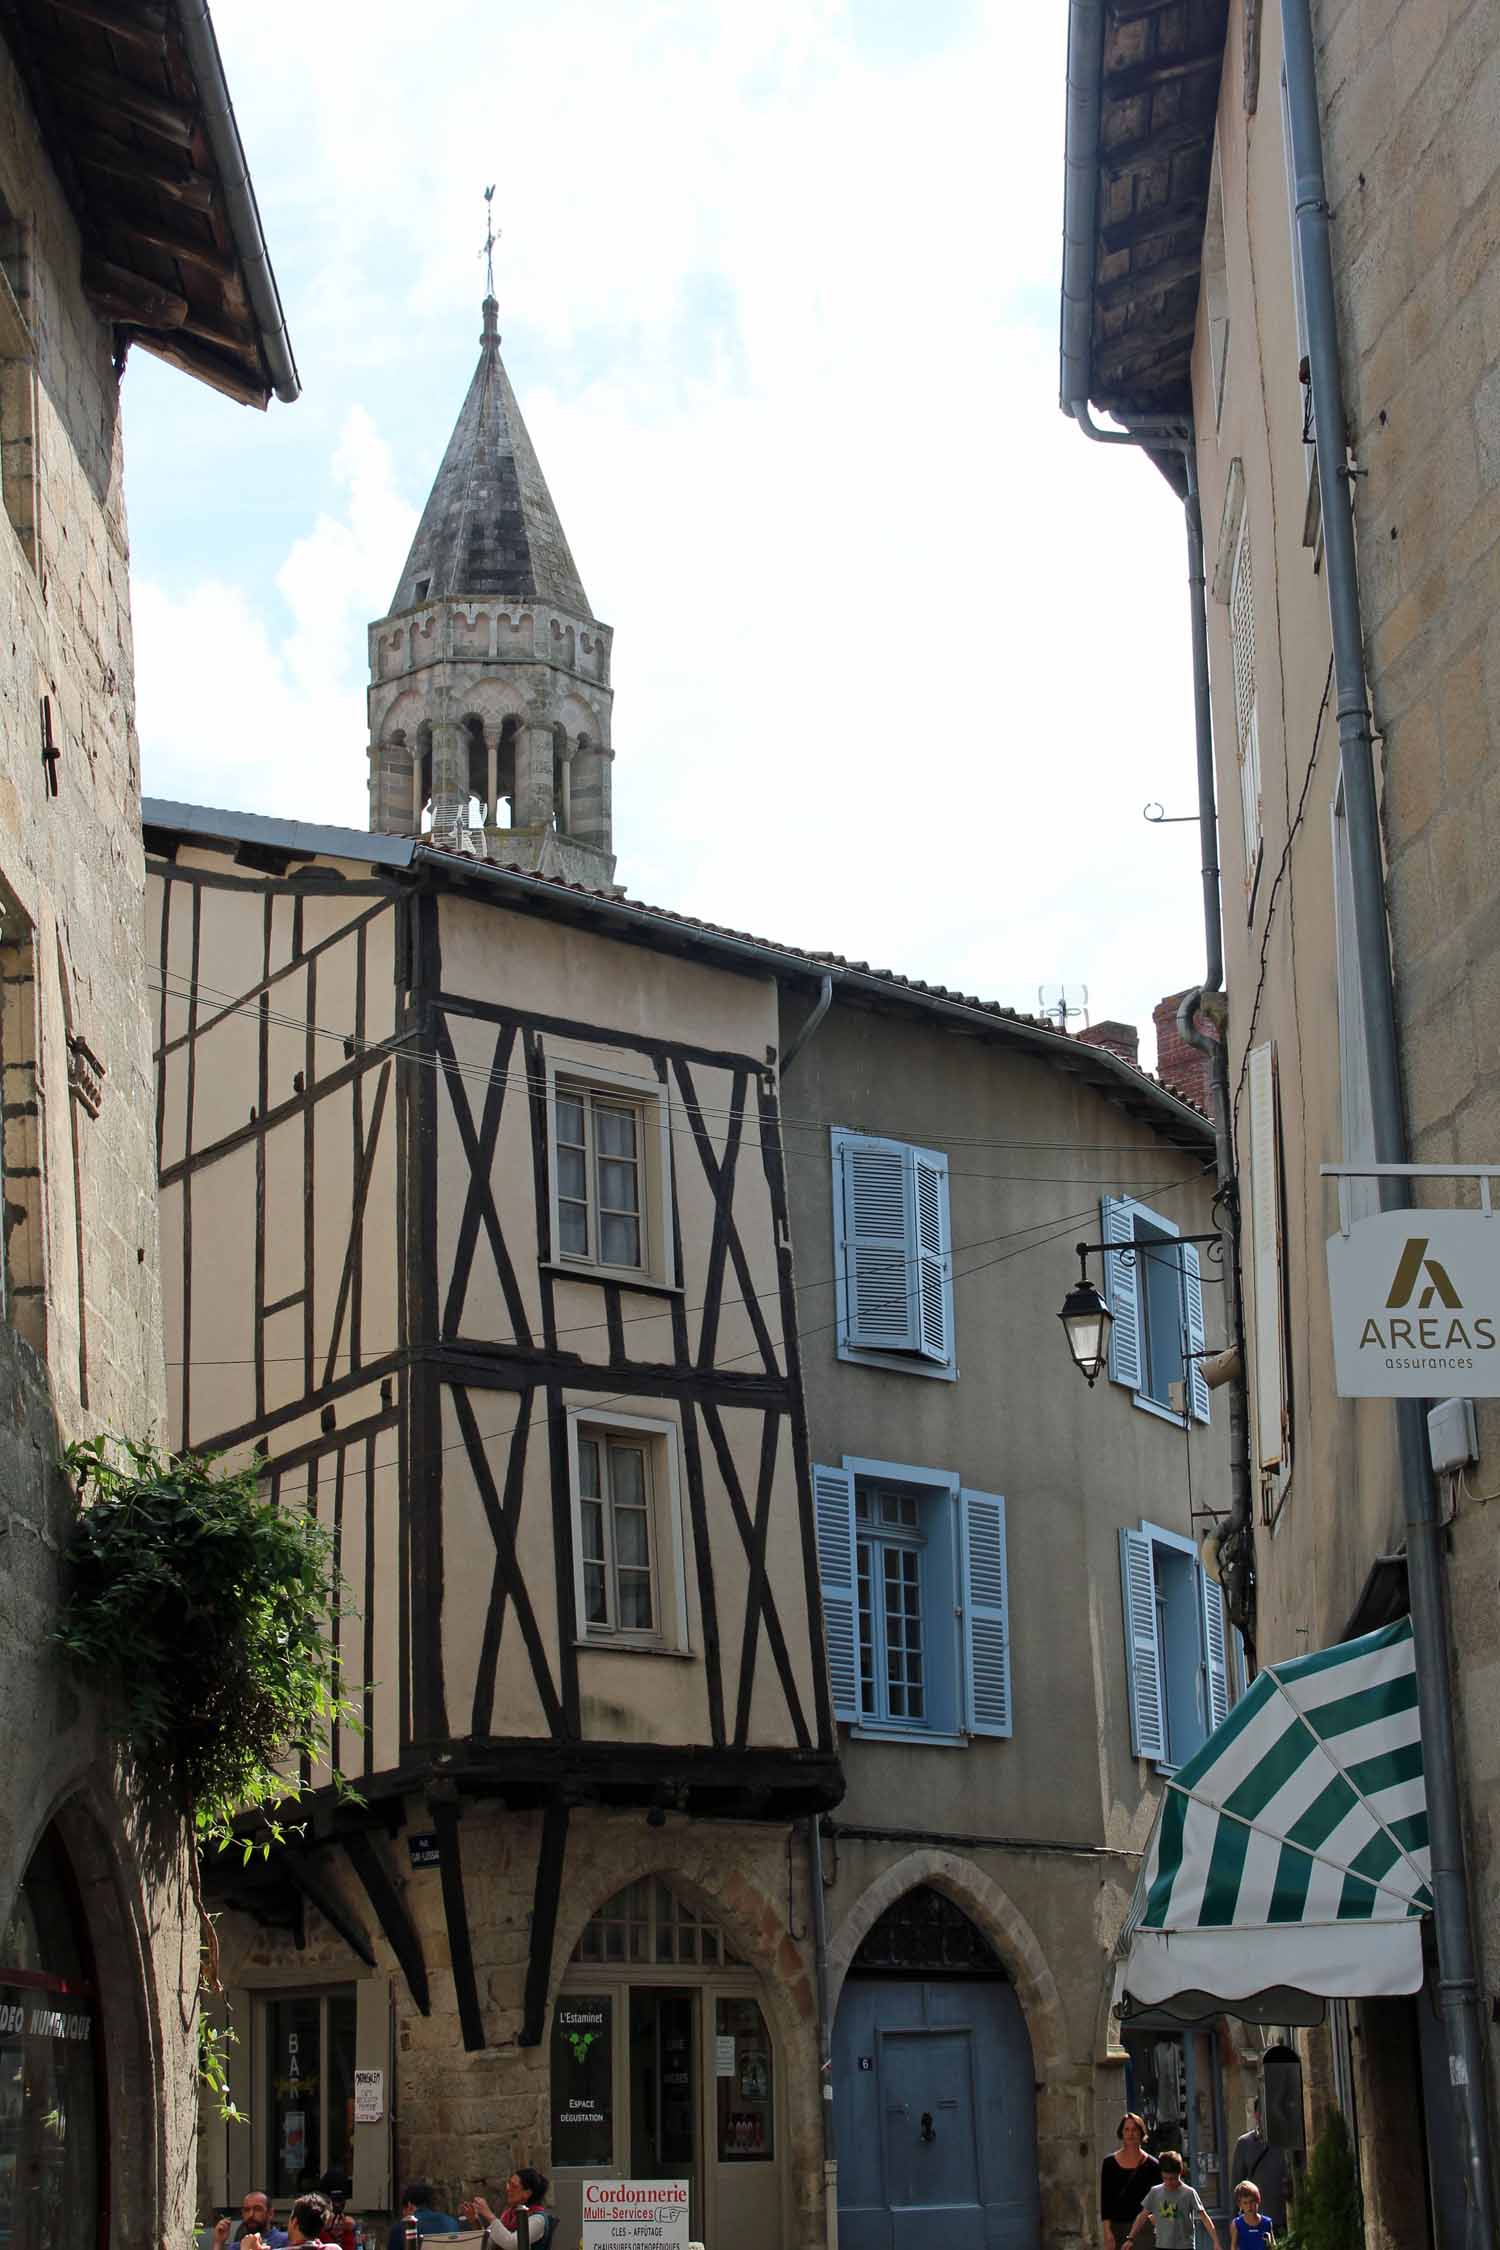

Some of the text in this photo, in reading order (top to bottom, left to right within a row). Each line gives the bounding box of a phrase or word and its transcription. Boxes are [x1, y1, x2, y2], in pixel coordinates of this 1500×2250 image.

[1359, 1318, 1496, 1350] AREAS
[1385, 1357, 1473, 1369] assurances
[560, 2012, 603, 2024] L'Estaminet
[862, 2058, 870, 2070] 6
[586, 2184, 687, 2203] Cordonnerie
[584, 2207, 654, 2219] Multi-Services
